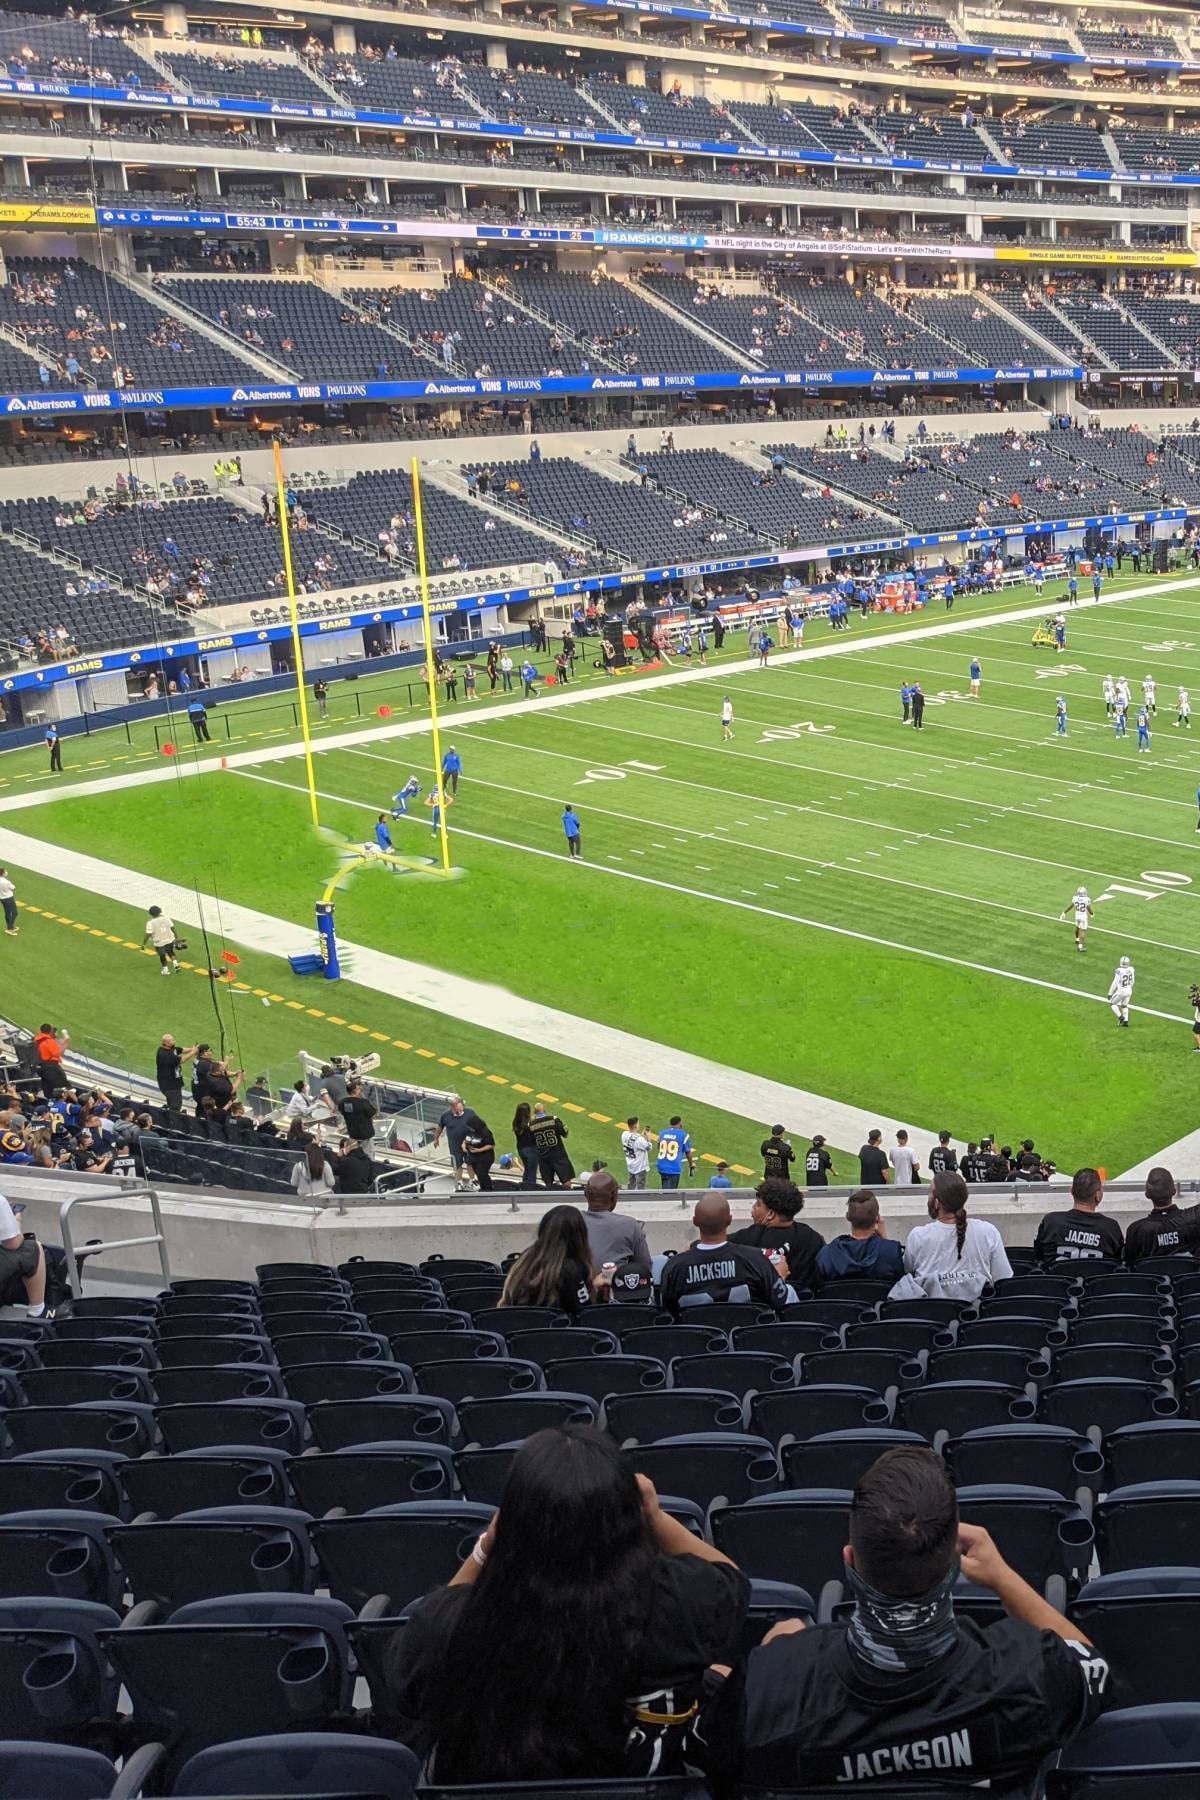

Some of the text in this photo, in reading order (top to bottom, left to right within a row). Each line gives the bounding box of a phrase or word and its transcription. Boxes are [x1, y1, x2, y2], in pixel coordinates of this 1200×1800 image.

[236, 216, 266, 227] 55:43
[602, 232, 689, 246] #RAMSHOUSE
[722, 238, 734, 248] NFL
[774, 240, 788, 251] City
[604, 376, 695, 388] Albertsons VONS PAVILIONS
[750, 376, 780, 384] Albertsons
[784, 374, 801, 384] VONS
[249, 384, 366, 401] Albertsons VONS PAVILIONS
[440, 380, 542, 394] Albertsons VONS PAVILIONS
[27, 392, 164, 410] Albertsons VONS PAVILIONS
[620, 573, 646, 584] RAMS
[528, 586, 556, 598] RAMS
[428, 600, 458, 613] RAMS
[319, 616, 352, 630] RAMS
[198, 637, 233, 651] RAMS
[66, 659, 103, 675] RAMS
[762, 720, 837, 740] 20
[584, 759, 668, 781] 10
[1104, 870, 1194, 901] 10
[1074, 901, 1086, 912] 22
[658, 1140, 680, 1162] 99
[806, 1158, 820, 1172] 28
[932, 1158, 946, 1174] 83
[1064, 1230, 1101, 1247] JACOBS
[1158, 1231, 1179, 1248] MOSS
[686, 1260, 736, 1285] JACKSON
[46, 1309, 56, 1319] N
[836, 1728, 973, 1782] JACKSON
